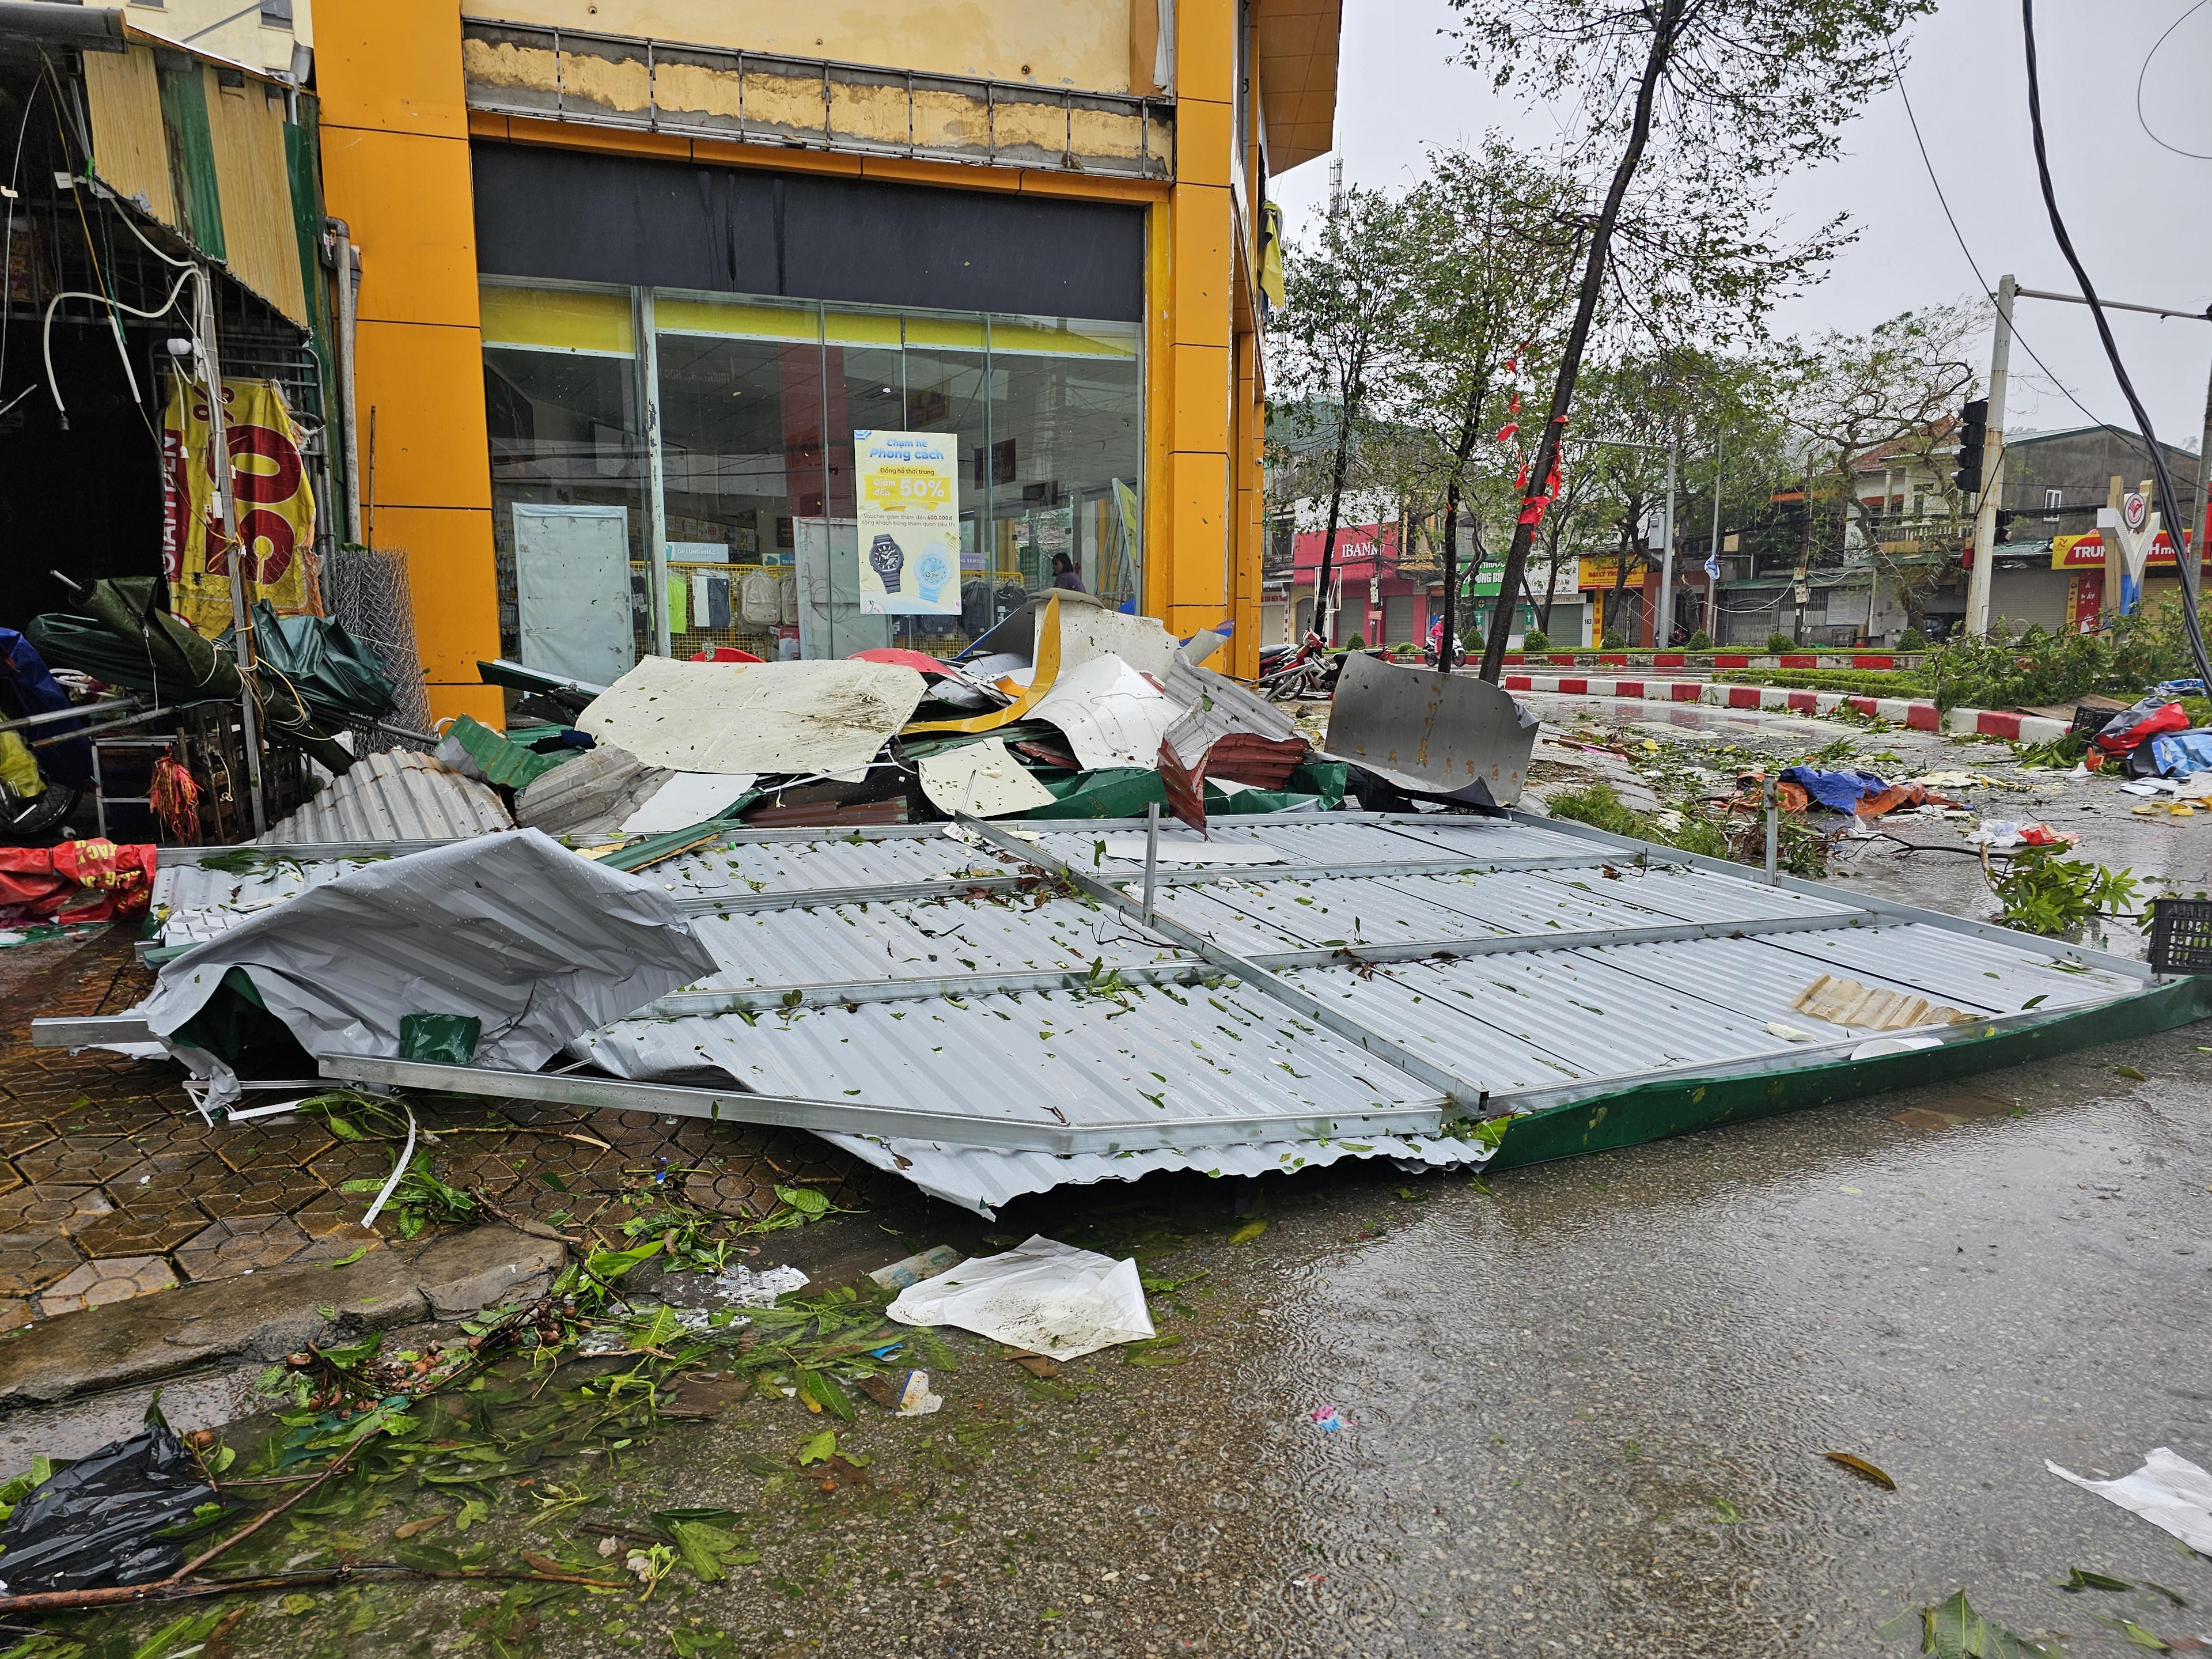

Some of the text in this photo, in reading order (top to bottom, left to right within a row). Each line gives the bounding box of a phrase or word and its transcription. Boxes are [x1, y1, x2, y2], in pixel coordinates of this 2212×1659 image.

[887, 439, 913, 448] Chạm
[870, 448, 944, 461] Phong cách
[899, 479, 945, 497] 50%
